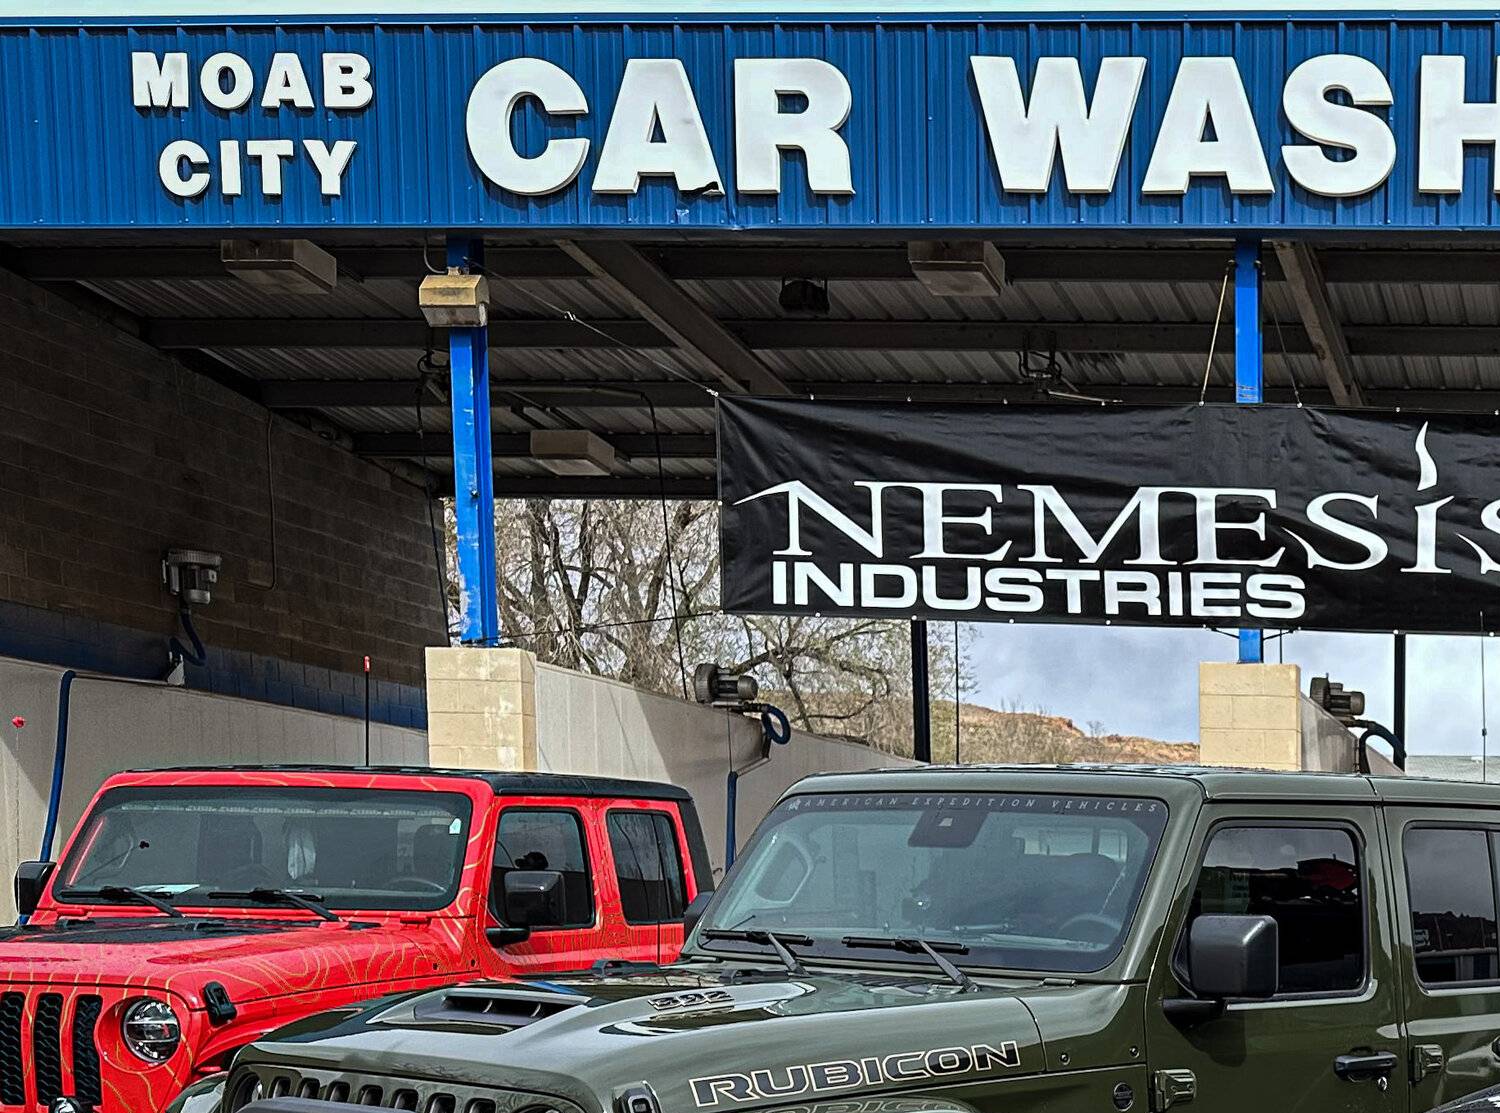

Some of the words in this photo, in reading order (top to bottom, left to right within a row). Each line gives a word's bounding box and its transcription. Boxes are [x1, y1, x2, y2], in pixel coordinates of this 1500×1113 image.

[131, 52, 374, 110] MOAB
[465, 56, 857, 196] CAR
[159, 140, 358, 197] CITY
[772, 561, 1307, 619] INDUSTRIES
[804, 797, 899, 807] AMERICAN
[911, 797, 1036, 808] EXPEDITION
[1051, 800, 1158, 812] VEHICLES
[688, 1040, 1021, 1107] RUBICON
